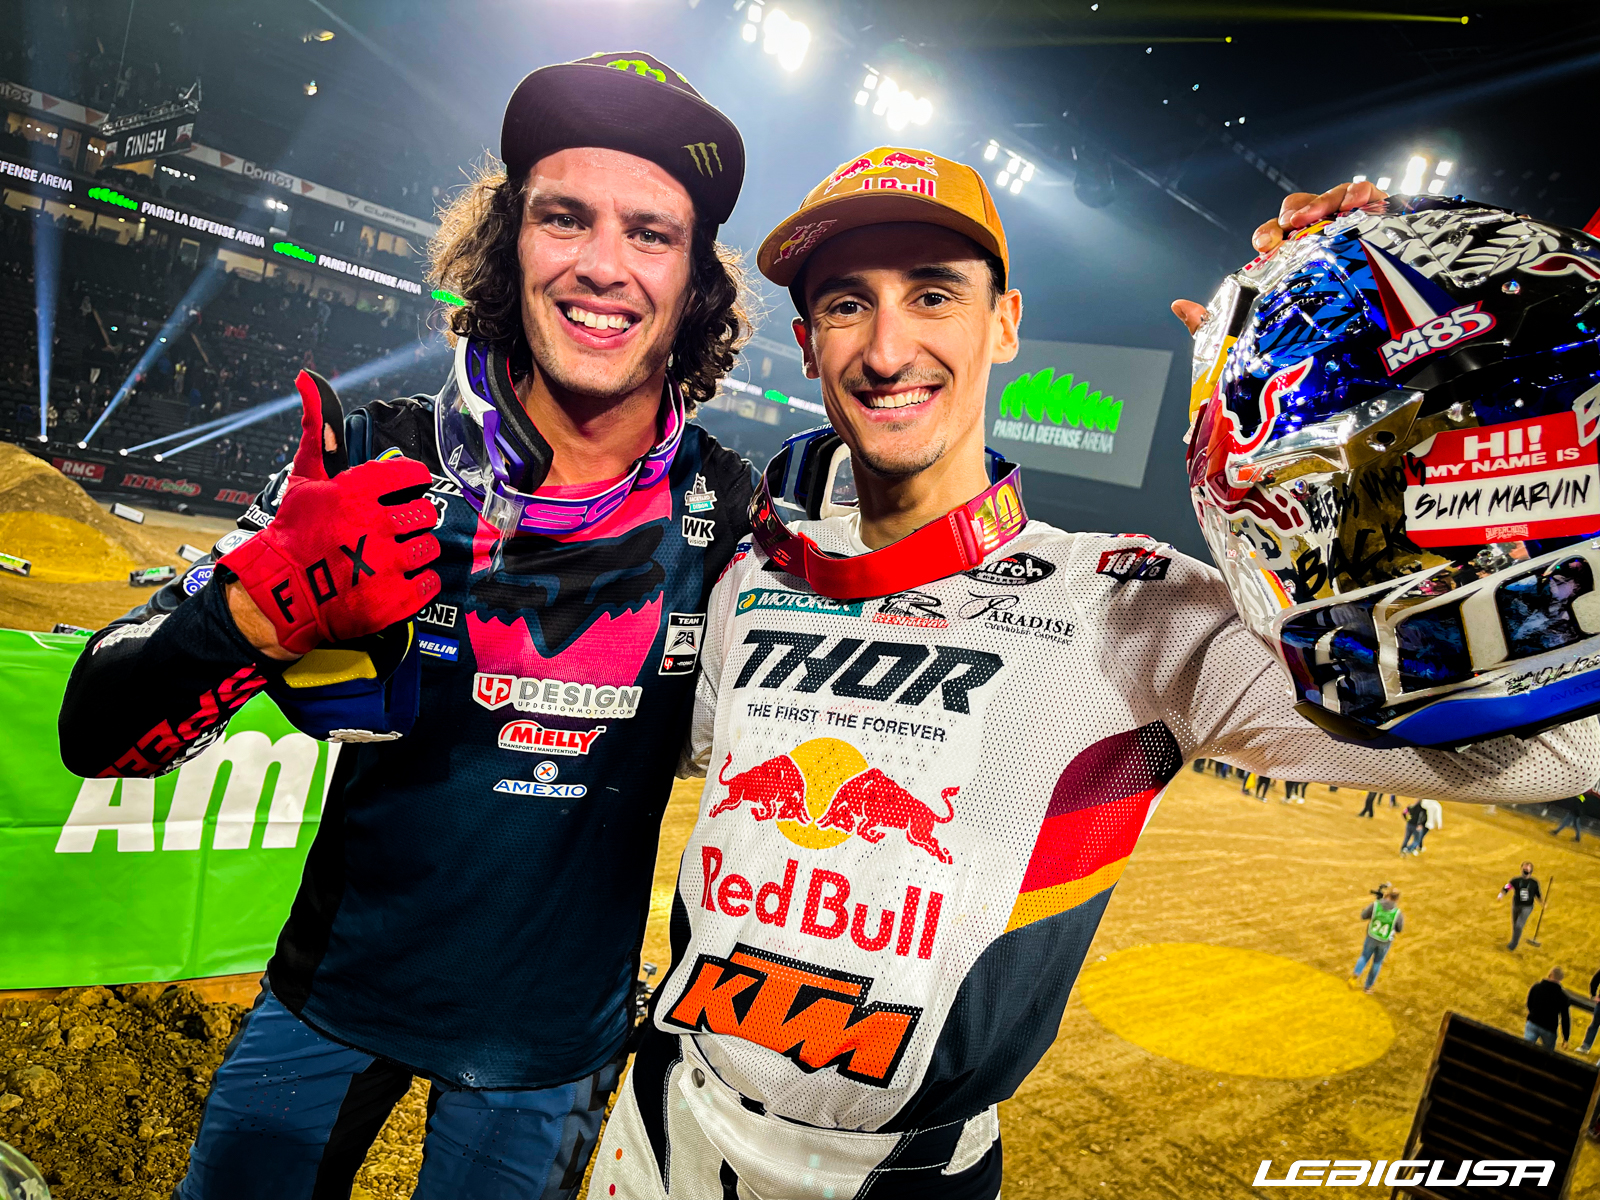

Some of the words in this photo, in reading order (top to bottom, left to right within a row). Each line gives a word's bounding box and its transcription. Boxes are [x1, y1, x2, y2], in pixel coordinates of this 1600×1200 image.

[124, 128, 167, 158] FINISH
[38, 172, 73, 192] ARENA
[243, 161, 294, 188] Doritos
[141, 201, 175, 221] PARIS
[174, 211, 189, 226] LA
[188, 215, 236, 240] DEFENSE
[234, 229, 265, 249] ARENA
[318, 254, 347, 273] PARIS
[345, 262, 359, 276] LA
[358, 266, 398, 288] DEFENSE
[396, 278, 422, 295] ARENA
[1378, 303, 1494, 374] M85
[992, 418, 1024, 441] PARIS
[1022, 423, 1036, 443] LA
[1035, 424, 1084, 449] DEFENSE
[1080, 431, 1115, 454] ARENA
[1463, 424, 1543, 461] HI!
[62, 460, 96, 476] RMC
[1425, 462, 1467, 478] MY
[1471, 451, 1548, 474] NAME
[1556, 447, 1580, 462] IS
[1414, 487, 1483, 520] SLIM
[1487, 474, 1592, 517] MARVIN
[683, 518, 713, 539] WK
[1485, 523, 1530, 539] SUPERCROSS
[271, 534, 376, 624] FOX
[871, 612, 949, 629] RENTHAL
[958, 589, 1077, 639] PARADISE
[732, 628, 1005, 716] THOR
[517, 679, 640, 709] DESIGN
[517, 701, 634, 716] UPDESIGNMOTO.COM
[746, 702, 772, 718] THE
[774, 706, 820, 723] FIRST
[826, 711, 859, 729] THE
[861, 716, 947, 743] FOREVER
[499, 742, 534, 751] TRANSPORT
[537, 746, 578, 755] MANUTENTION
[495, 779, 587, 797] AMEXIO
[700, 844, 799, 928] Red
[799, 867, 944, 961] Bull
[1372, 919, 1391, 938] 24
[663, 943, 922, 1088] KTM
